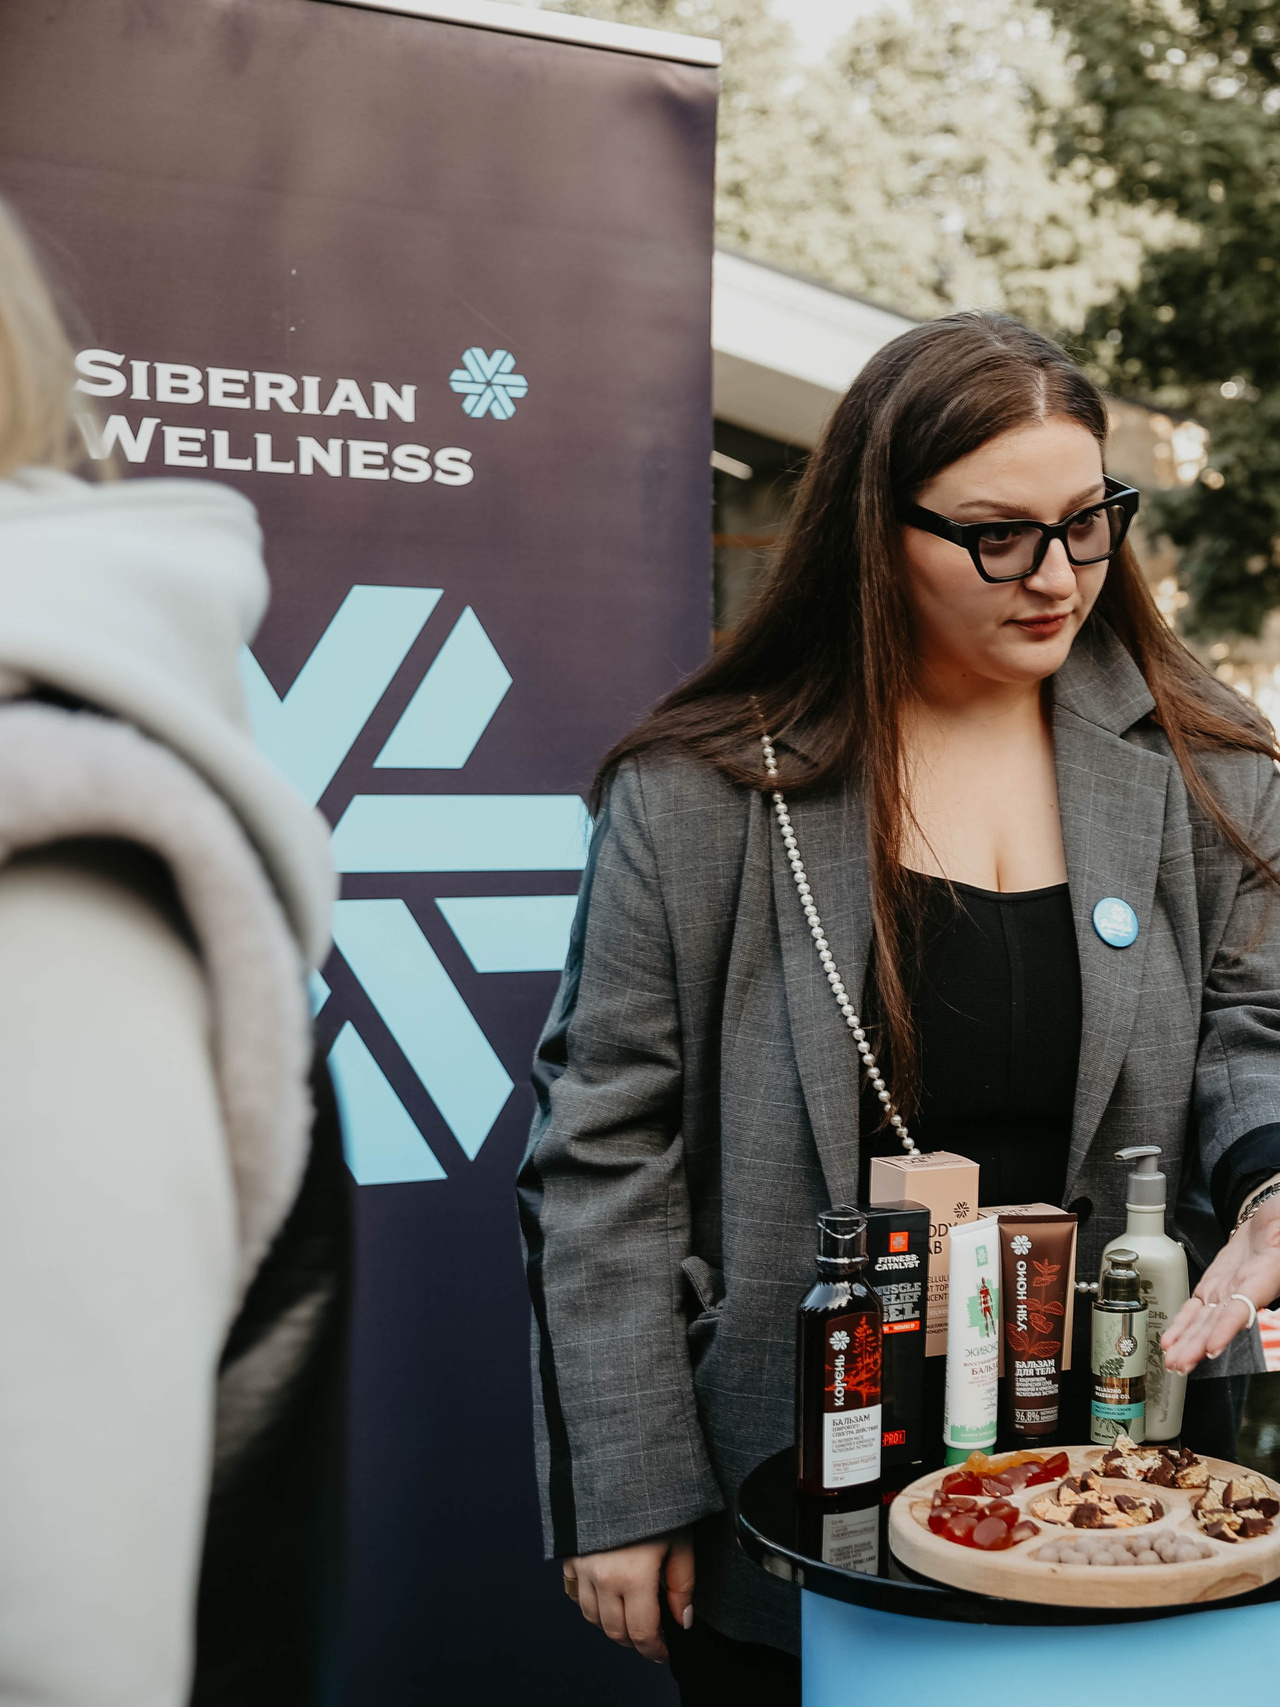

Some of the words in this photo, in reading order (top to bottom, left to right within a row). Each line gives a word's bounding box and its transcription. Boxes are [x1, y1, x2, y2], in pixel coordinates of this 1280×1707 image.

[74, 348, 417, 423] SIBERIAN
[73, 413, 475, 486] WELLNESS
[874, 1260, 920, 1271] CATALYST
[882, 1292, 922, 1305] ELIEF
[1015, 1359, 1056, 1369] БАЛЬЗАМ
[1015, 1368, 1034, 1377] ДЛЯ
[1036, 1366, 1056, 1376] ТЕЛА
[832, 1414, 870, 1426] БАЛЬЗАМ
